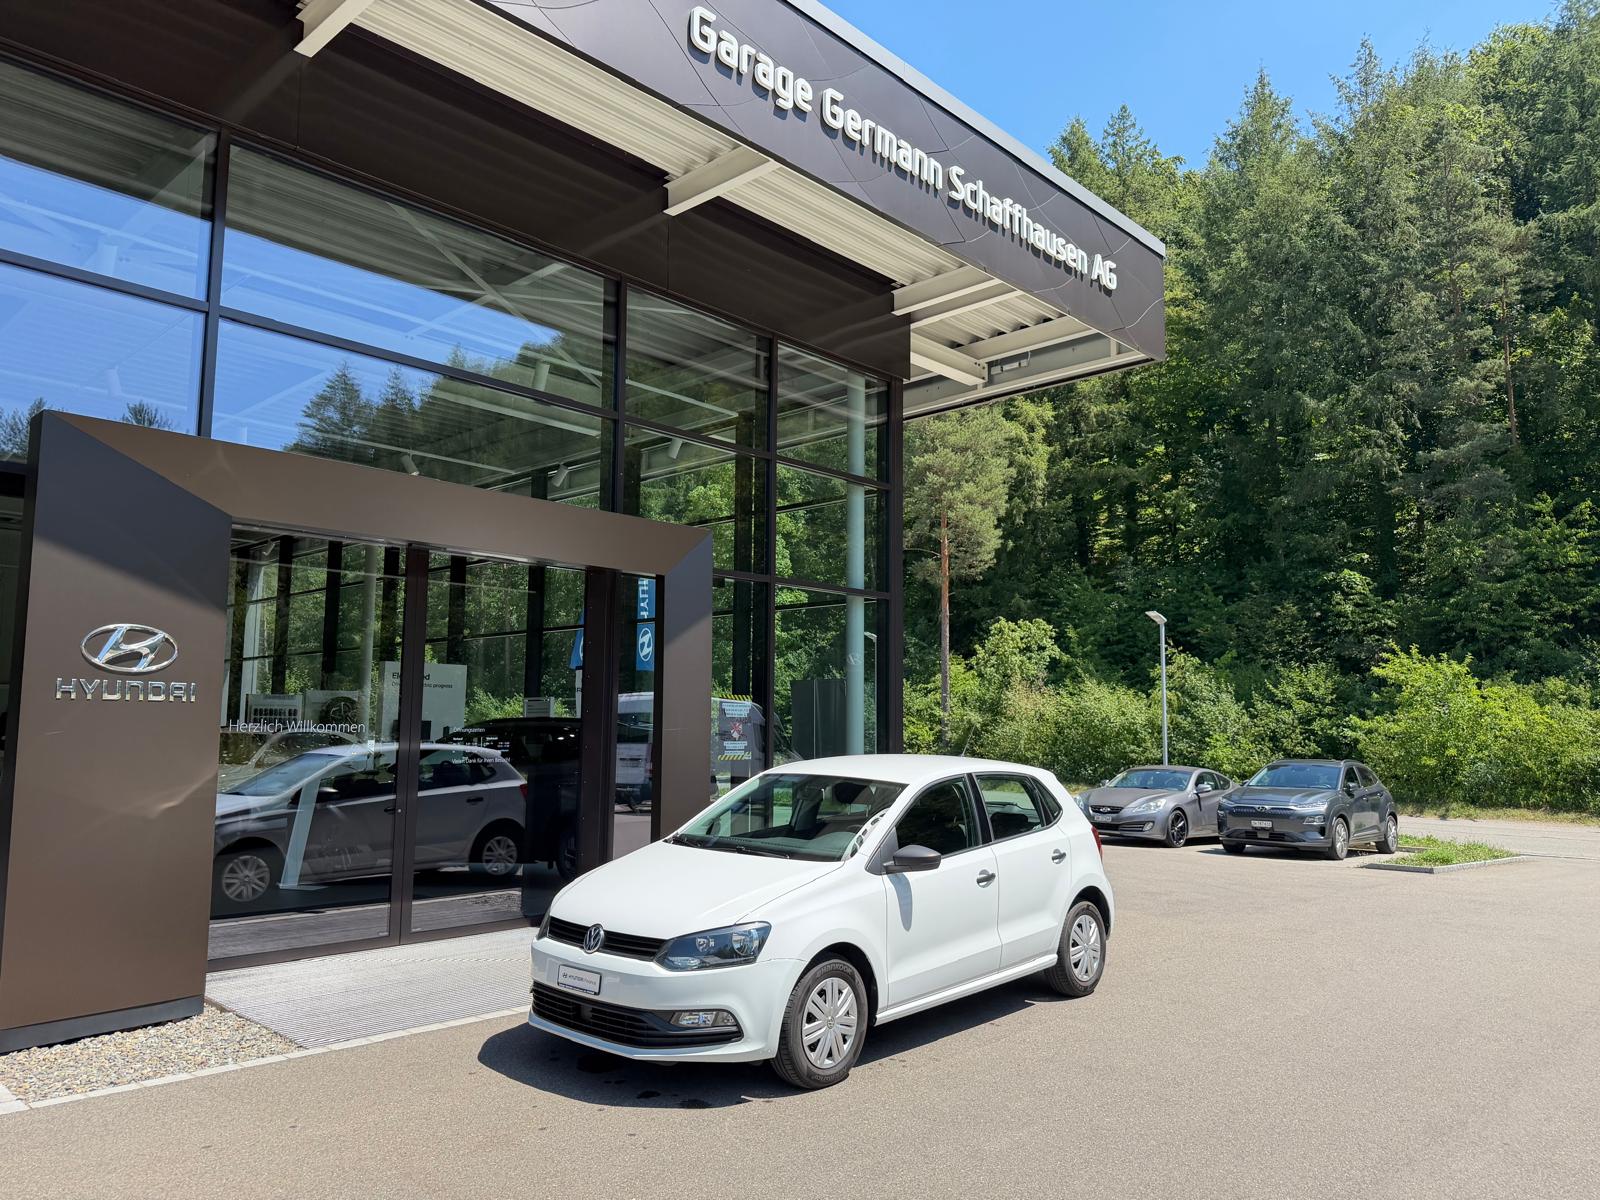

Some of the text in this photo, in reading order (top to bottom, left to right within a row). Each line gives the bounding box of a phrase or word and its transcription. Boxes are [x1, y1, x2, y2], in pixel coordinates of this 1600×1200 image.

[689, 5, 1118, 291] Garage Germann Schaffhausen AG
[55, 677, 196, 702] HYUNDAI
[229, 719, 366, 733] Herzlich Willkommen
